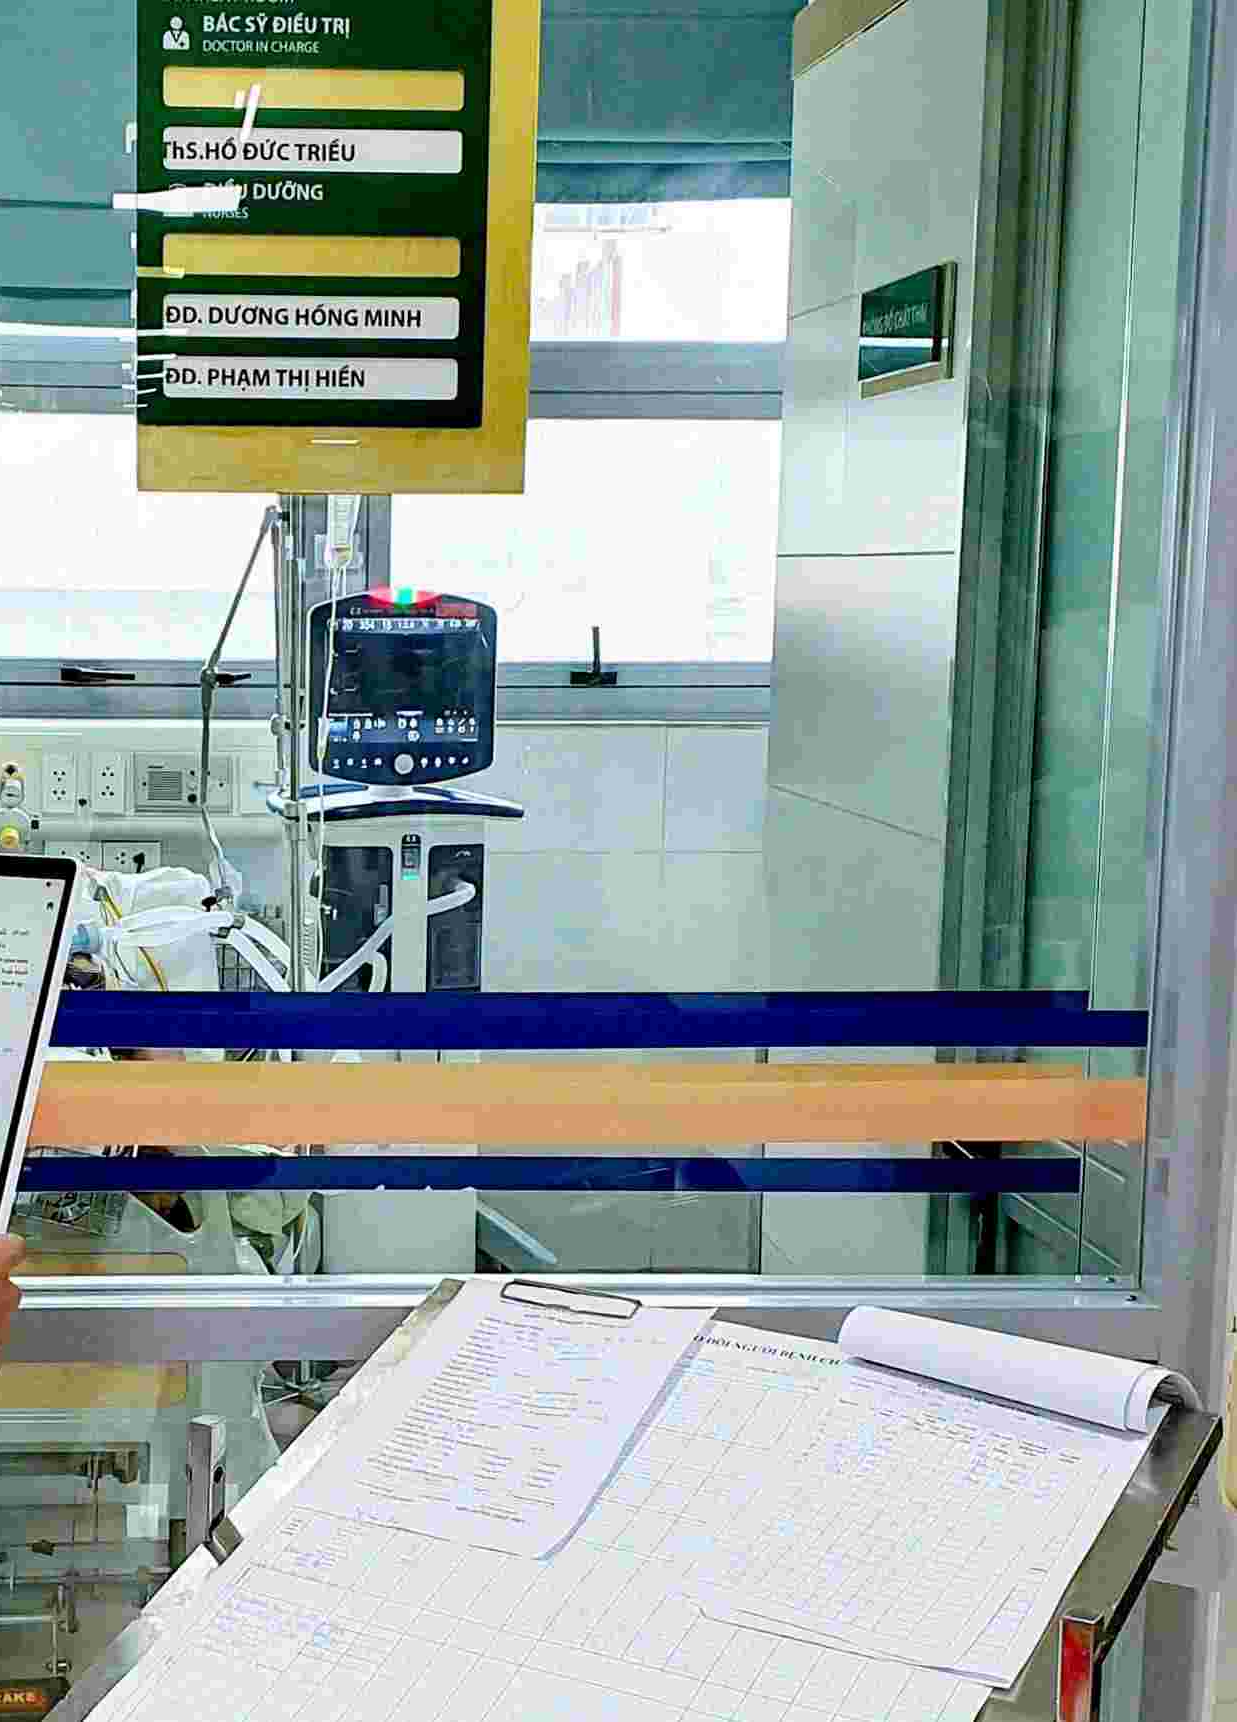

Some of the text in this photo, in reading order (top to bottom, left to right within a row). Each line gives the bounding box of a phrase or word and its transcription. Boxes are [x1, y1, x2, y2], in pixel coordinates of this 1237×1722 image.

[202, 12, 241, 33] BÁC
[321, 17, 351, 39] TRỊ
[202, 40, 320, 54] DOCTOR IN CHARGE
[242, 139, 290, 161] ĐỨC
[166, 306, 202, 325] ĐD.
[209, 305, 289, 327] DƯƠNG
[364, 308, 422, 328] MINH
[207, 369, 271, 391] PHẠM
[276, 370, 310, 392] THỊ
